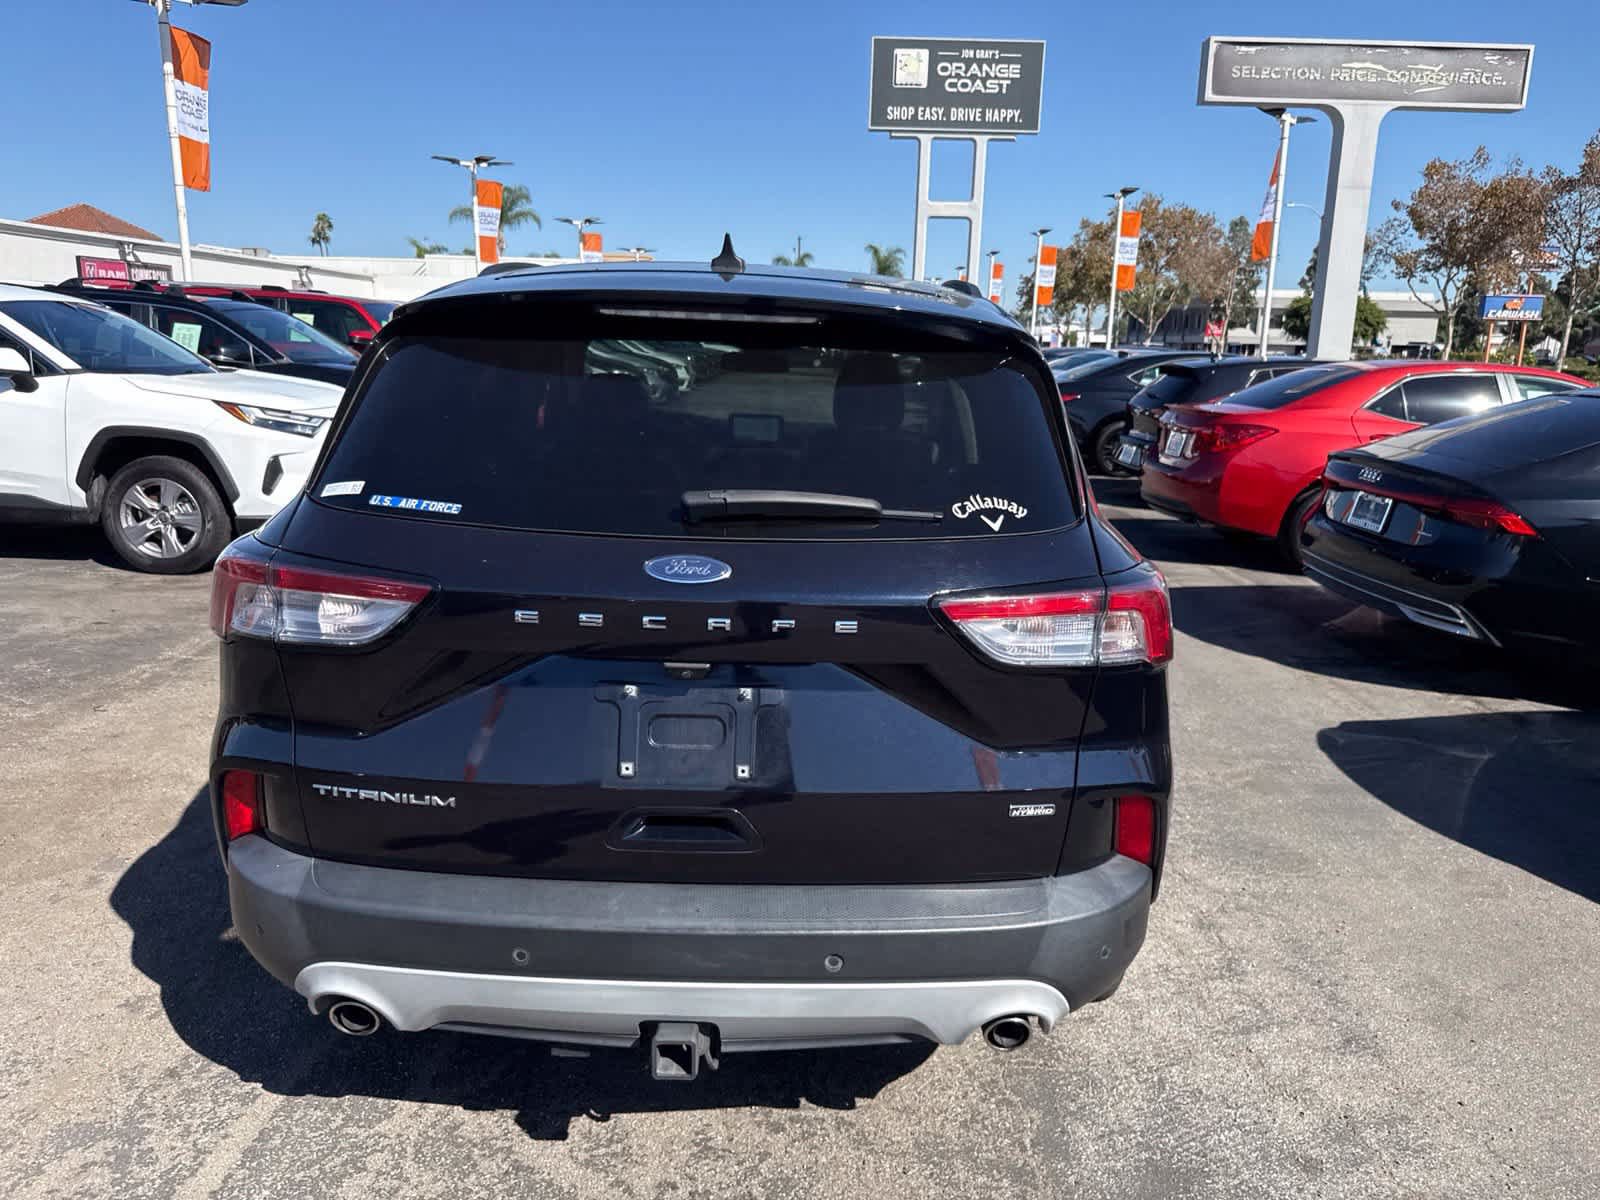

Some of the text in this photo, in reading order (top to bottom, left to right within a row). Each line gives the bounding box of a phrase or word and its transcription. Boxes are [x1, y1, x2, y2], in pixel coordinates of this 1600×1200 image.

[961, 49, 1000, 60] JON GRAY'S
[937, 62, 1021, 78] ORANGE
[1231, 65, 1325, 80] SELECTION.
[944, 78, 1012, 94] COAST
[887, 106, 1023, 123] SHOP EASY. DRIVE HAPPY.
[98, 268, 126, 280] RAM
[369, 495, 463, 514] U.S. AIR FORCE
[951, 493, 1028, 519] Callaway
[664, 559, 712, 577] Ford
[514, 609, 858, 634] ESCAPE
[312, 783, 457, 808] TITANIUM
[1011, 807, 1053, 817] HYBRID
